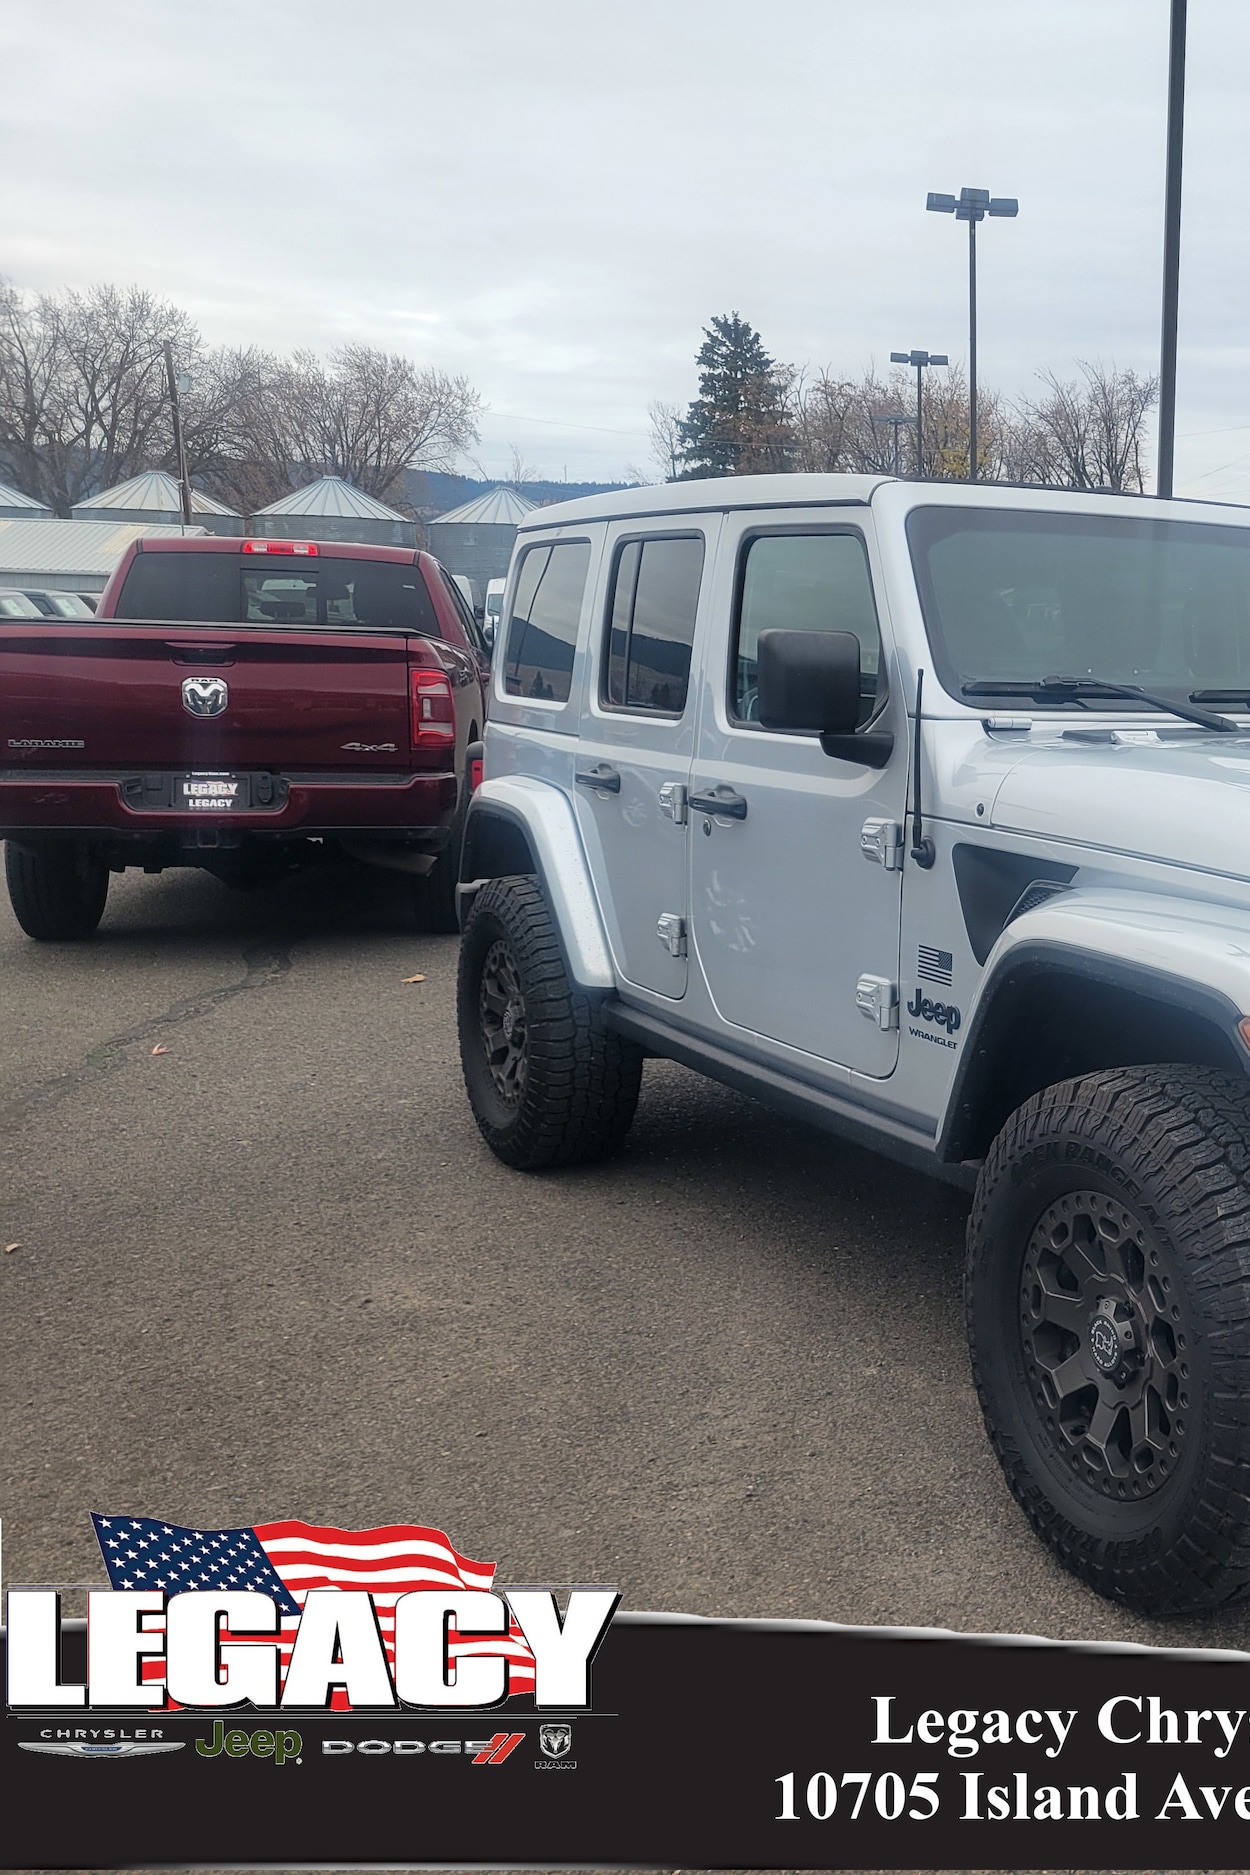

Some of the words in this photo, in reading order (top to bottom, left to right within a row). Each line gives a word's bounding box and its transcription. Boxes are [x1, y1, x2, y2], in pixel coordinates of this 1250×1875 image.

[183, 783, 239, 796] LEGACY
[188, 799, 233, 808] LEGACY
[907, 988, 961, 1035] Jeep
